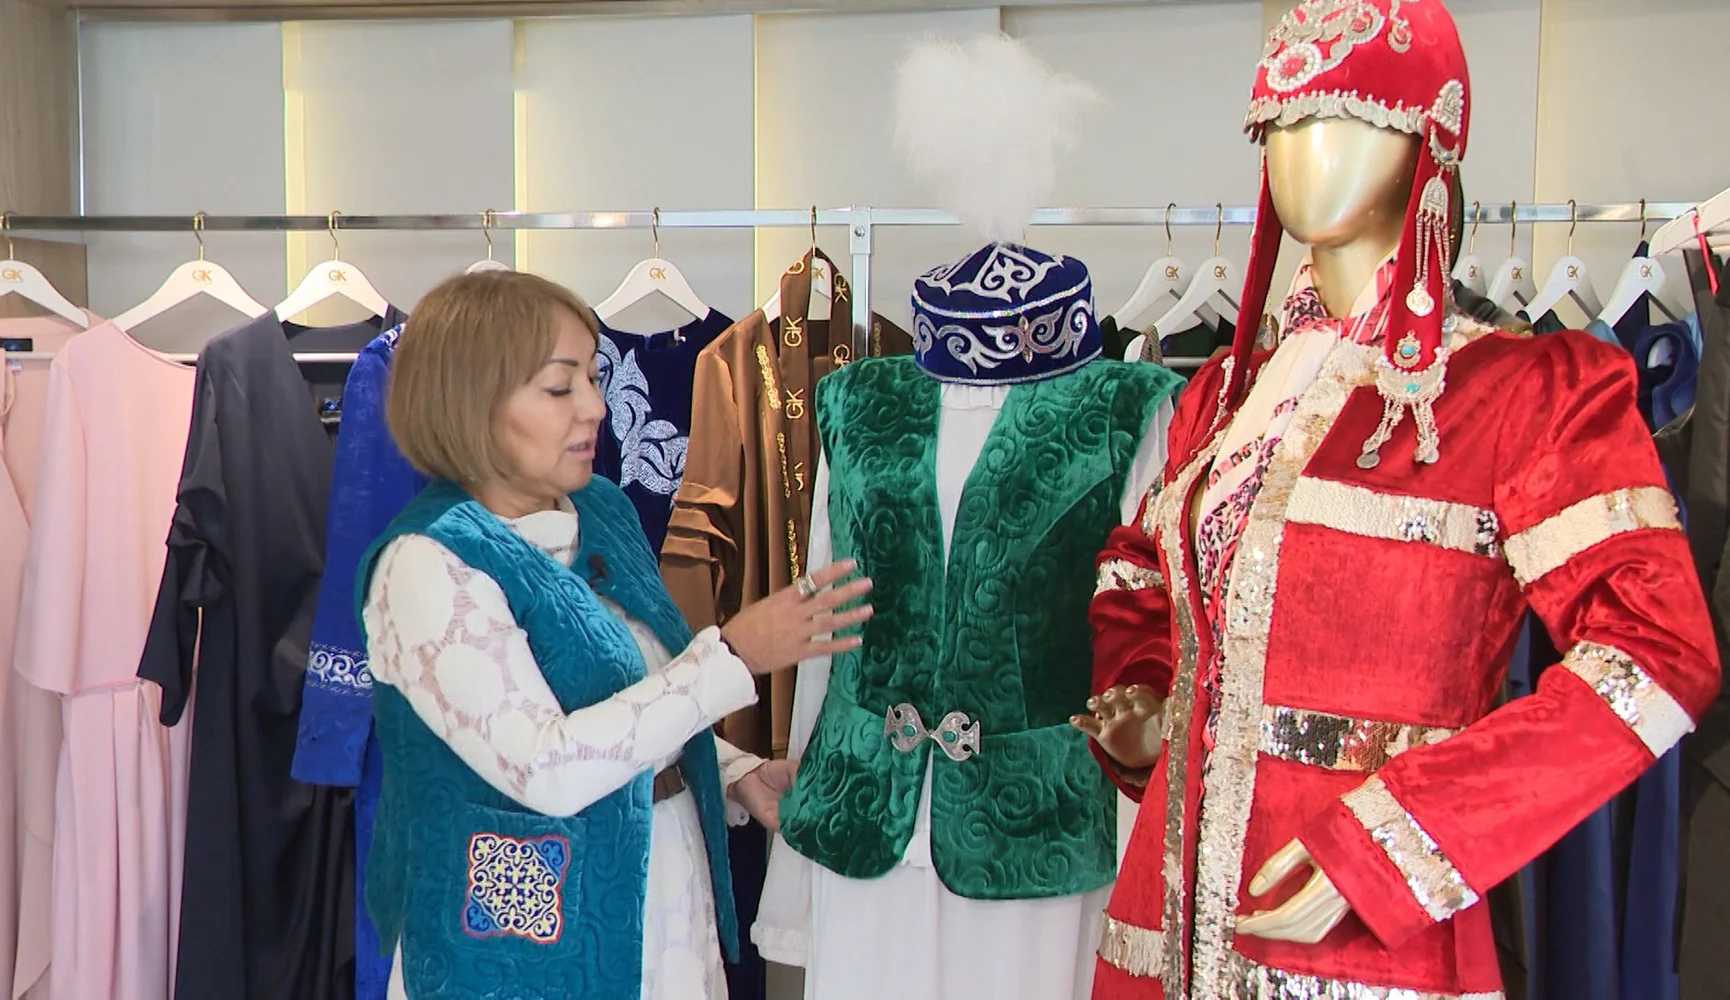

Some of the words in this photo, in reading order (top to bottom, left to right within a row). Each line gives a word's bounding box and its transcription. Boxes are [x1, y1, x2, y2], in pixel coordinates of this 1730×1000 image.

[2, 269, 22, 281] GK
[192, 270, 212, 281] GK
[328, 270, 347, 282] GK
[649, 267, 666, 280] GK
[1165, 266, 1179, 279] GK
[1214, 266, 1227, 279] GK
[1511, 266, 1523, 280] GK
[1567, 265, 1579, 279] GK
[1640, 265, 1653, 278] GK
[784, 316, 803, 347] GK
[785, 388, 804, 419] GK
